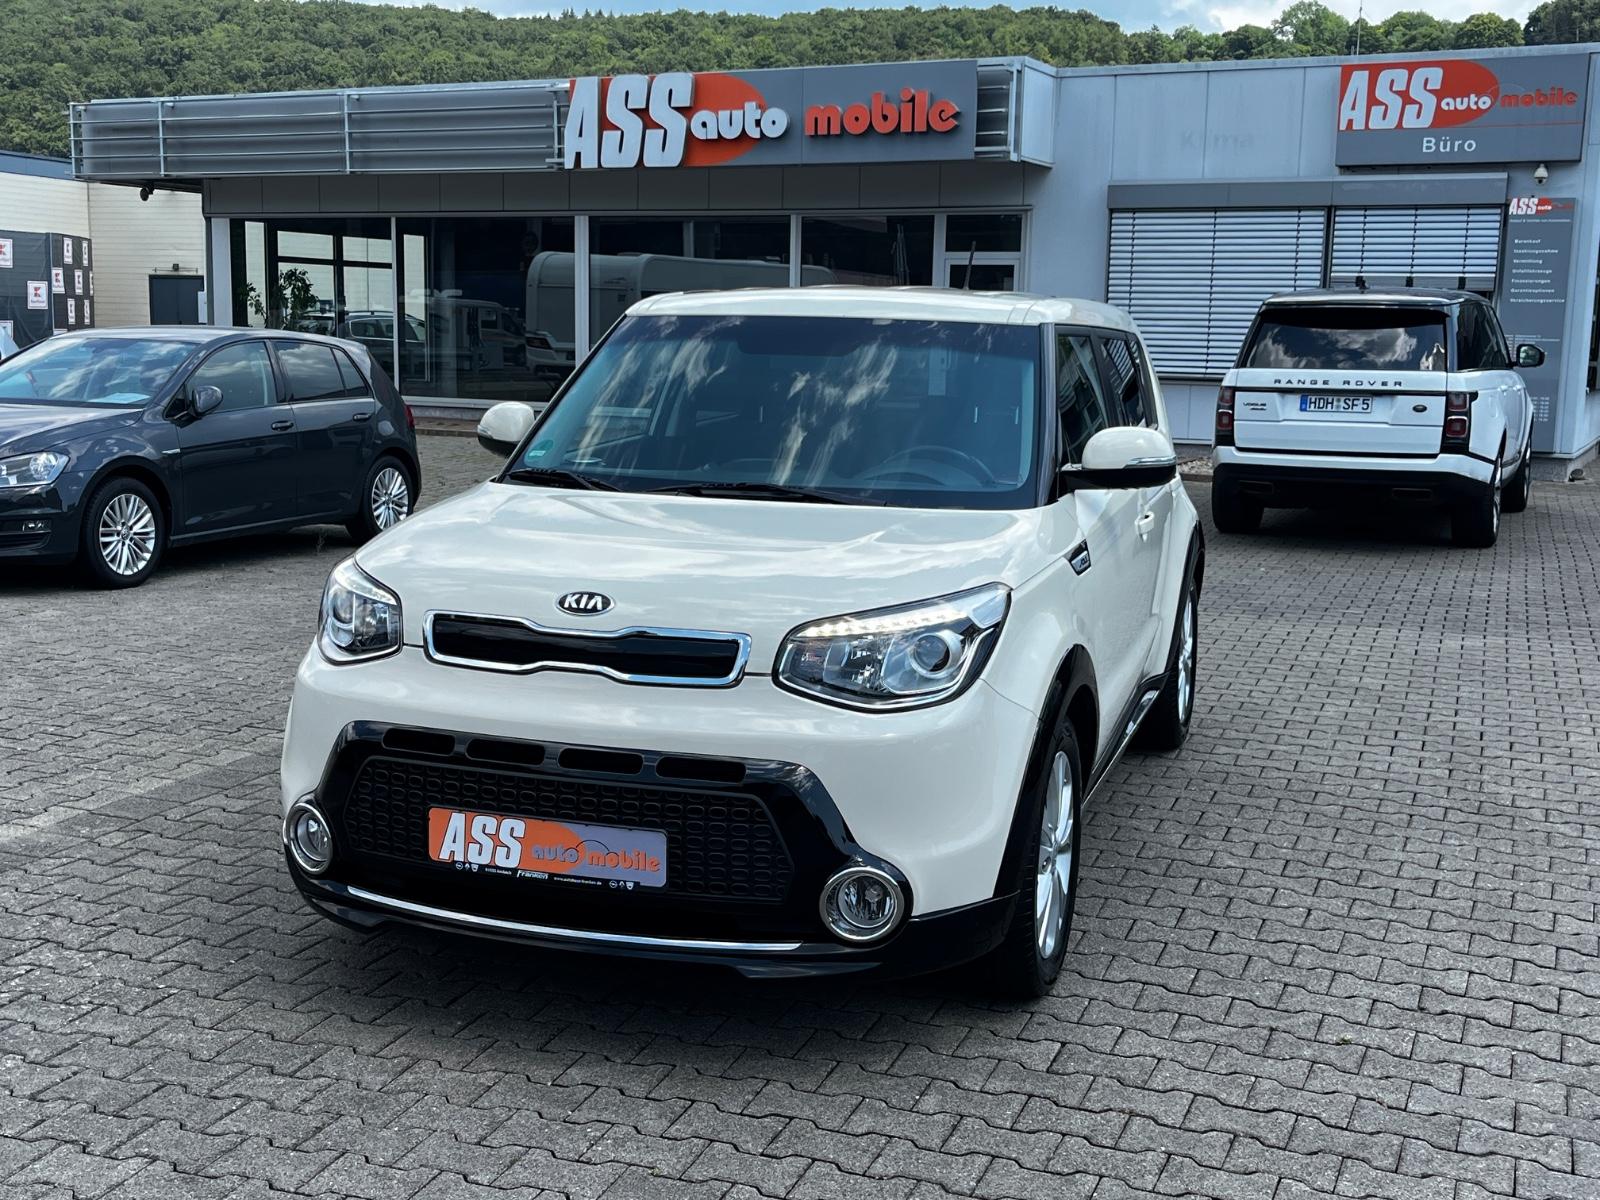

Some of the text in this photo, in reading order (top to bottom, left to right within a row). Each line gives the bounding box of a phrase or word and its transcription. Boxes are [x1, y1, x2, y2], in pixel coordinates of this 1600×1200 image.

[1339, 67, 1578, 131] ASS auto mobile
[564, 72, 961, 169] ASS auto mobile
[1422, 136, 1477, 153] Büro
[1508, 197, 1539, 215] ASS
[1308, 397, 1335, 410] HDH
[563, 594, 603, 611] KIA
[438, 812, 661, 873] ASS auto mobile
